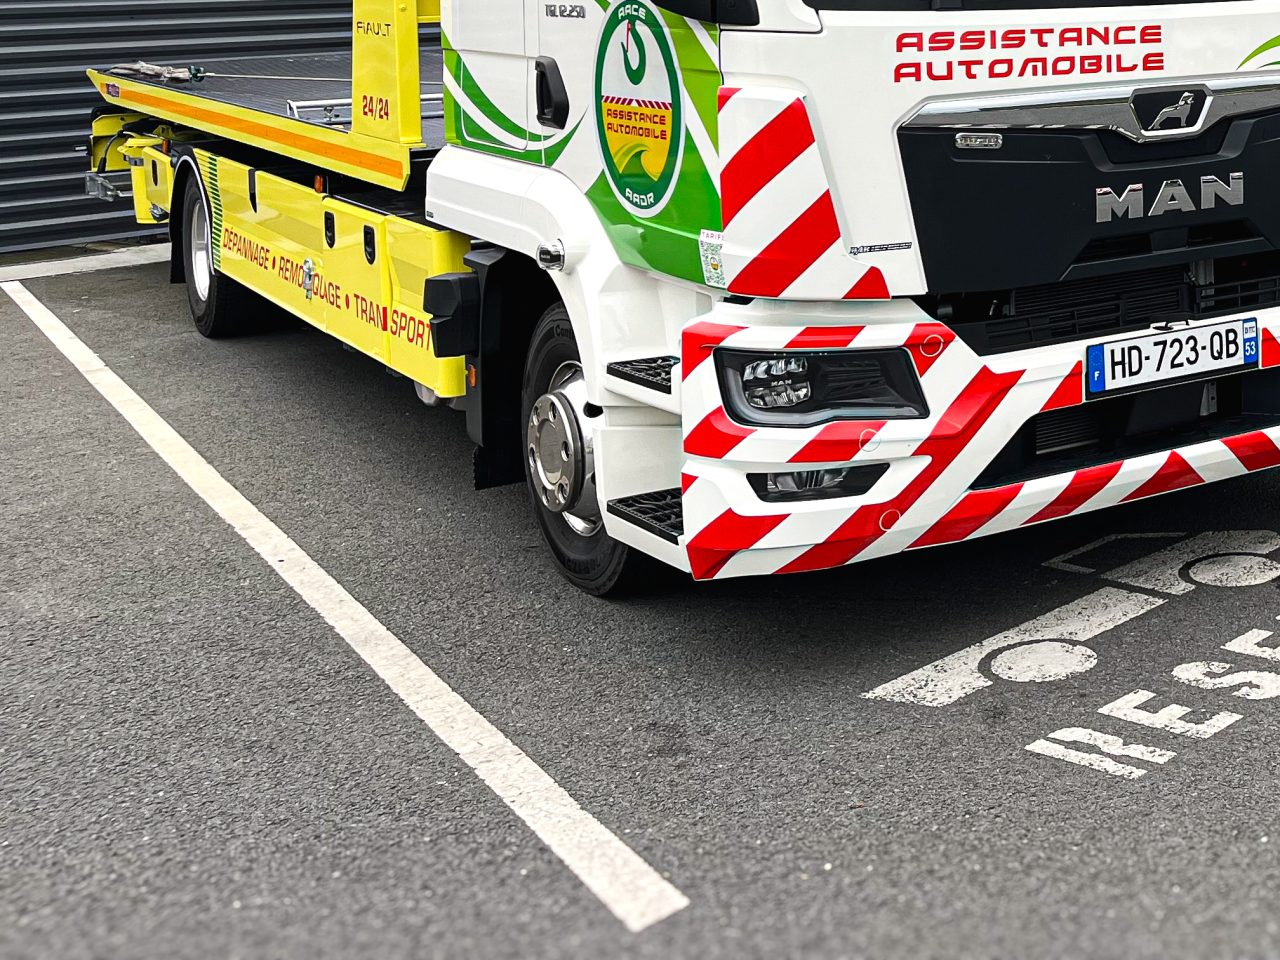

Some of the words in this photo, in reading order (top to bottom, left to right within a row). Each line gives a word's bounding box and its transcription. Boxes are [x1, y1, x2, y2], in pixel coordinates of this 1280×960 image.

[618, 4, 647, 20] AACE
[894, 24, 1163, 53] ASSISTANCE
[892, 51, 1165, 84] AUTOMOBILE
[362, 94, 390, 121] 24/24
[606, 108, 667, 126] ASSISTANCE
[606, 122, 668, 141] AUTOMOBILE
[625, 187, 655, 207] AADR
[1094, 171, 1245, 224] MAN
[222, 227, 271, 271] DÉPANNAGE
[278, 255, 342, 310] REMOQUAGE
[1094, 370, 1100, 381] F
[1110, 328, 1240, 381] HD-723-QB
[1245, 340, 1256, 356] 53
